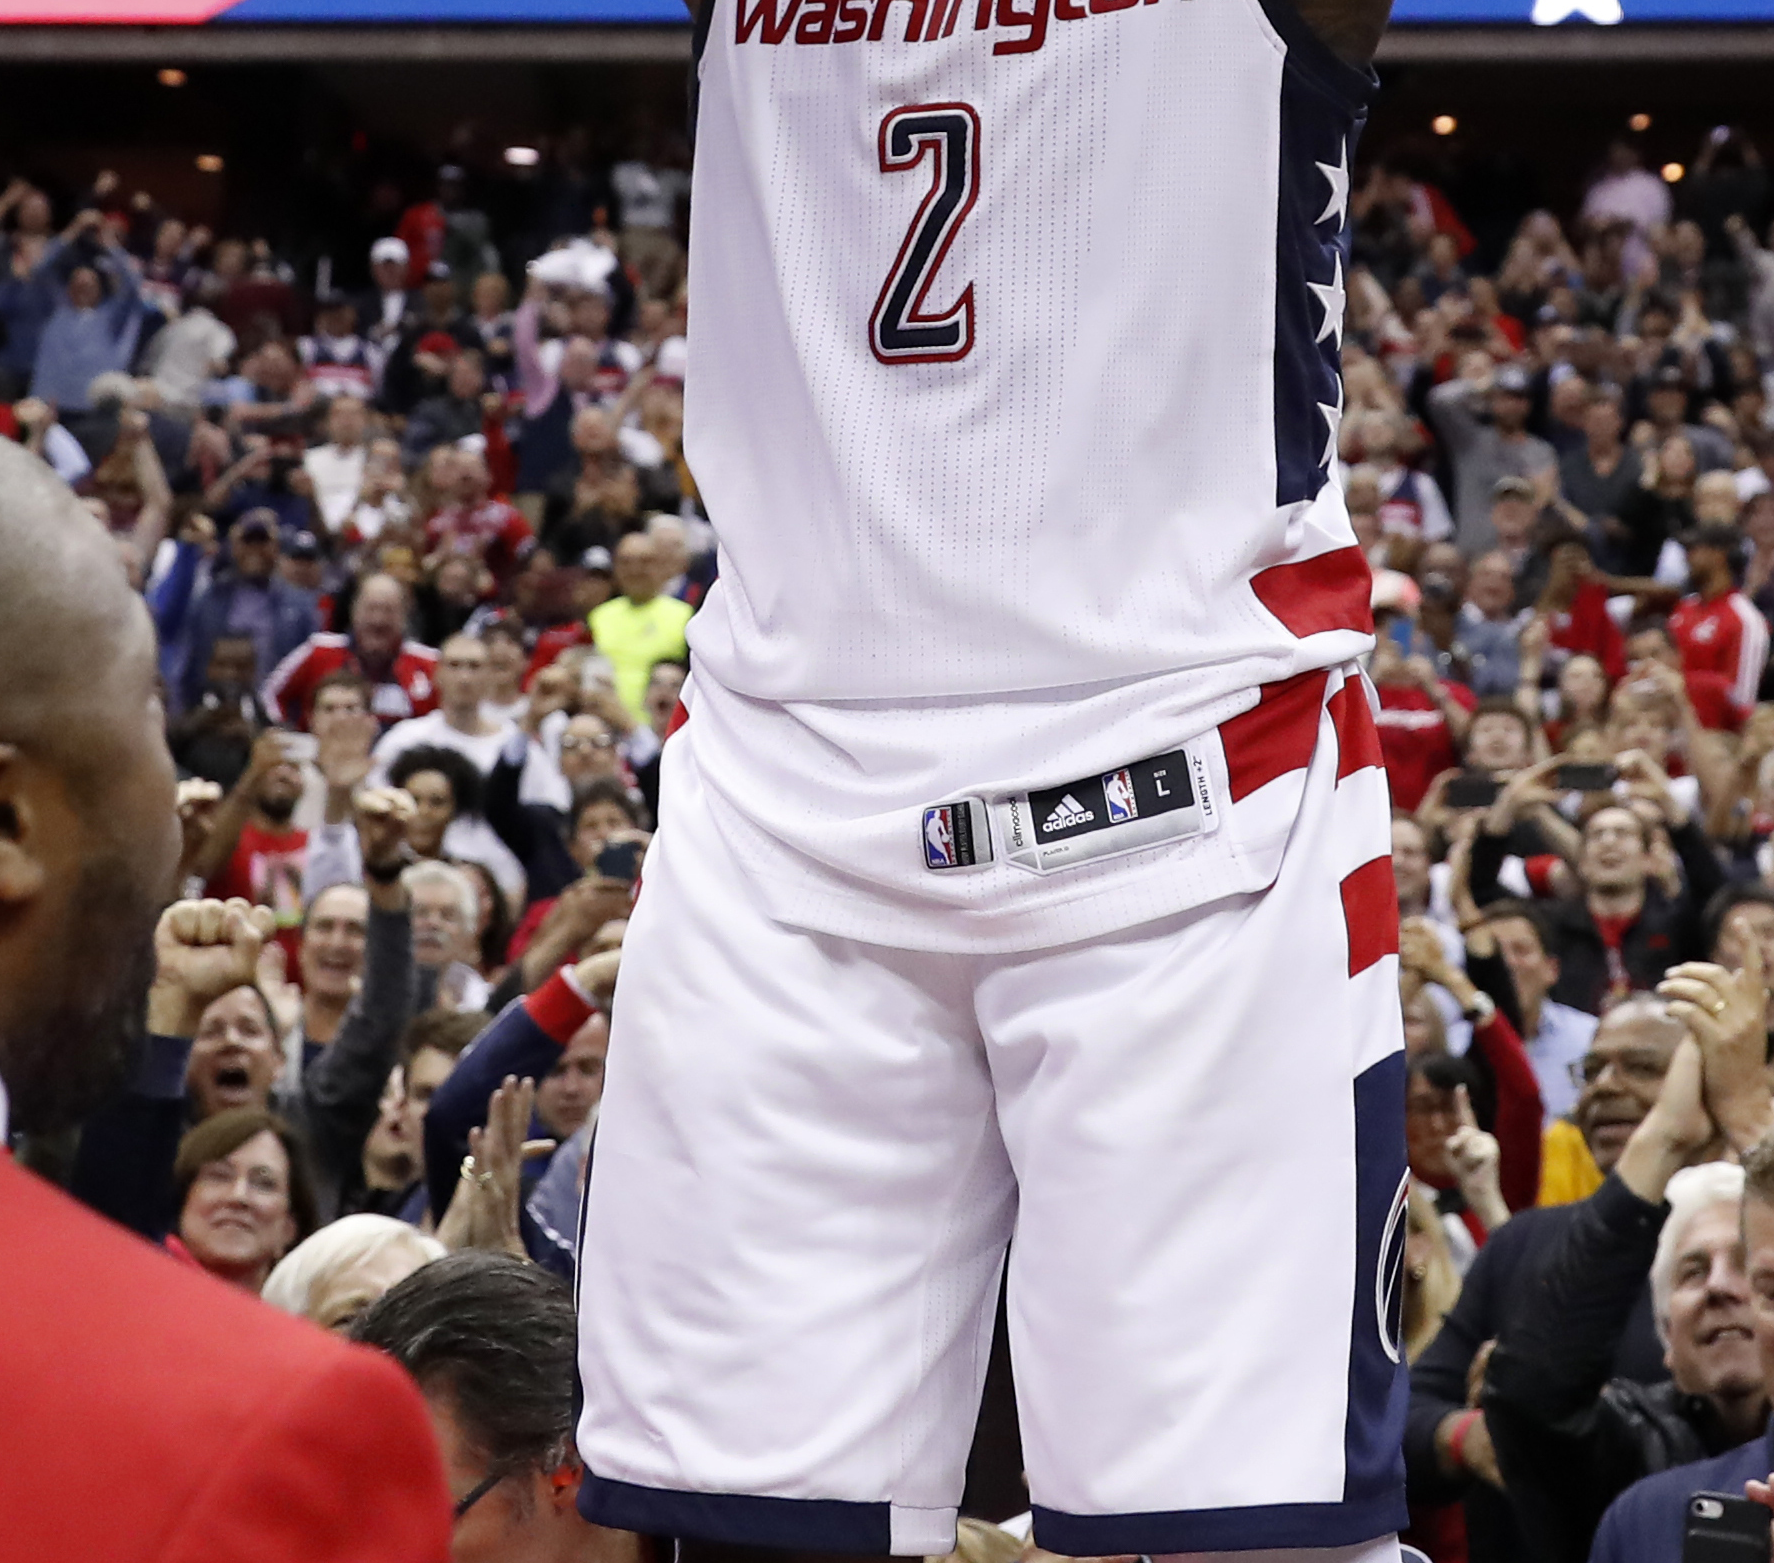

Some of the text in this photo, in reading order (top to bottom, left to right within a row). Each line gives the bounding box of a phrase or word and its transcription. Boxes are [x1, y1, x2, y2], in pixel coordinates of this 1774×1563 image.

[868, 101, 982, 366] 2
[1155, 779, 1171, 797] L
[1197, 776, 1213, 817] LENGTH
[1042, 810, 1095, 833] adidas
